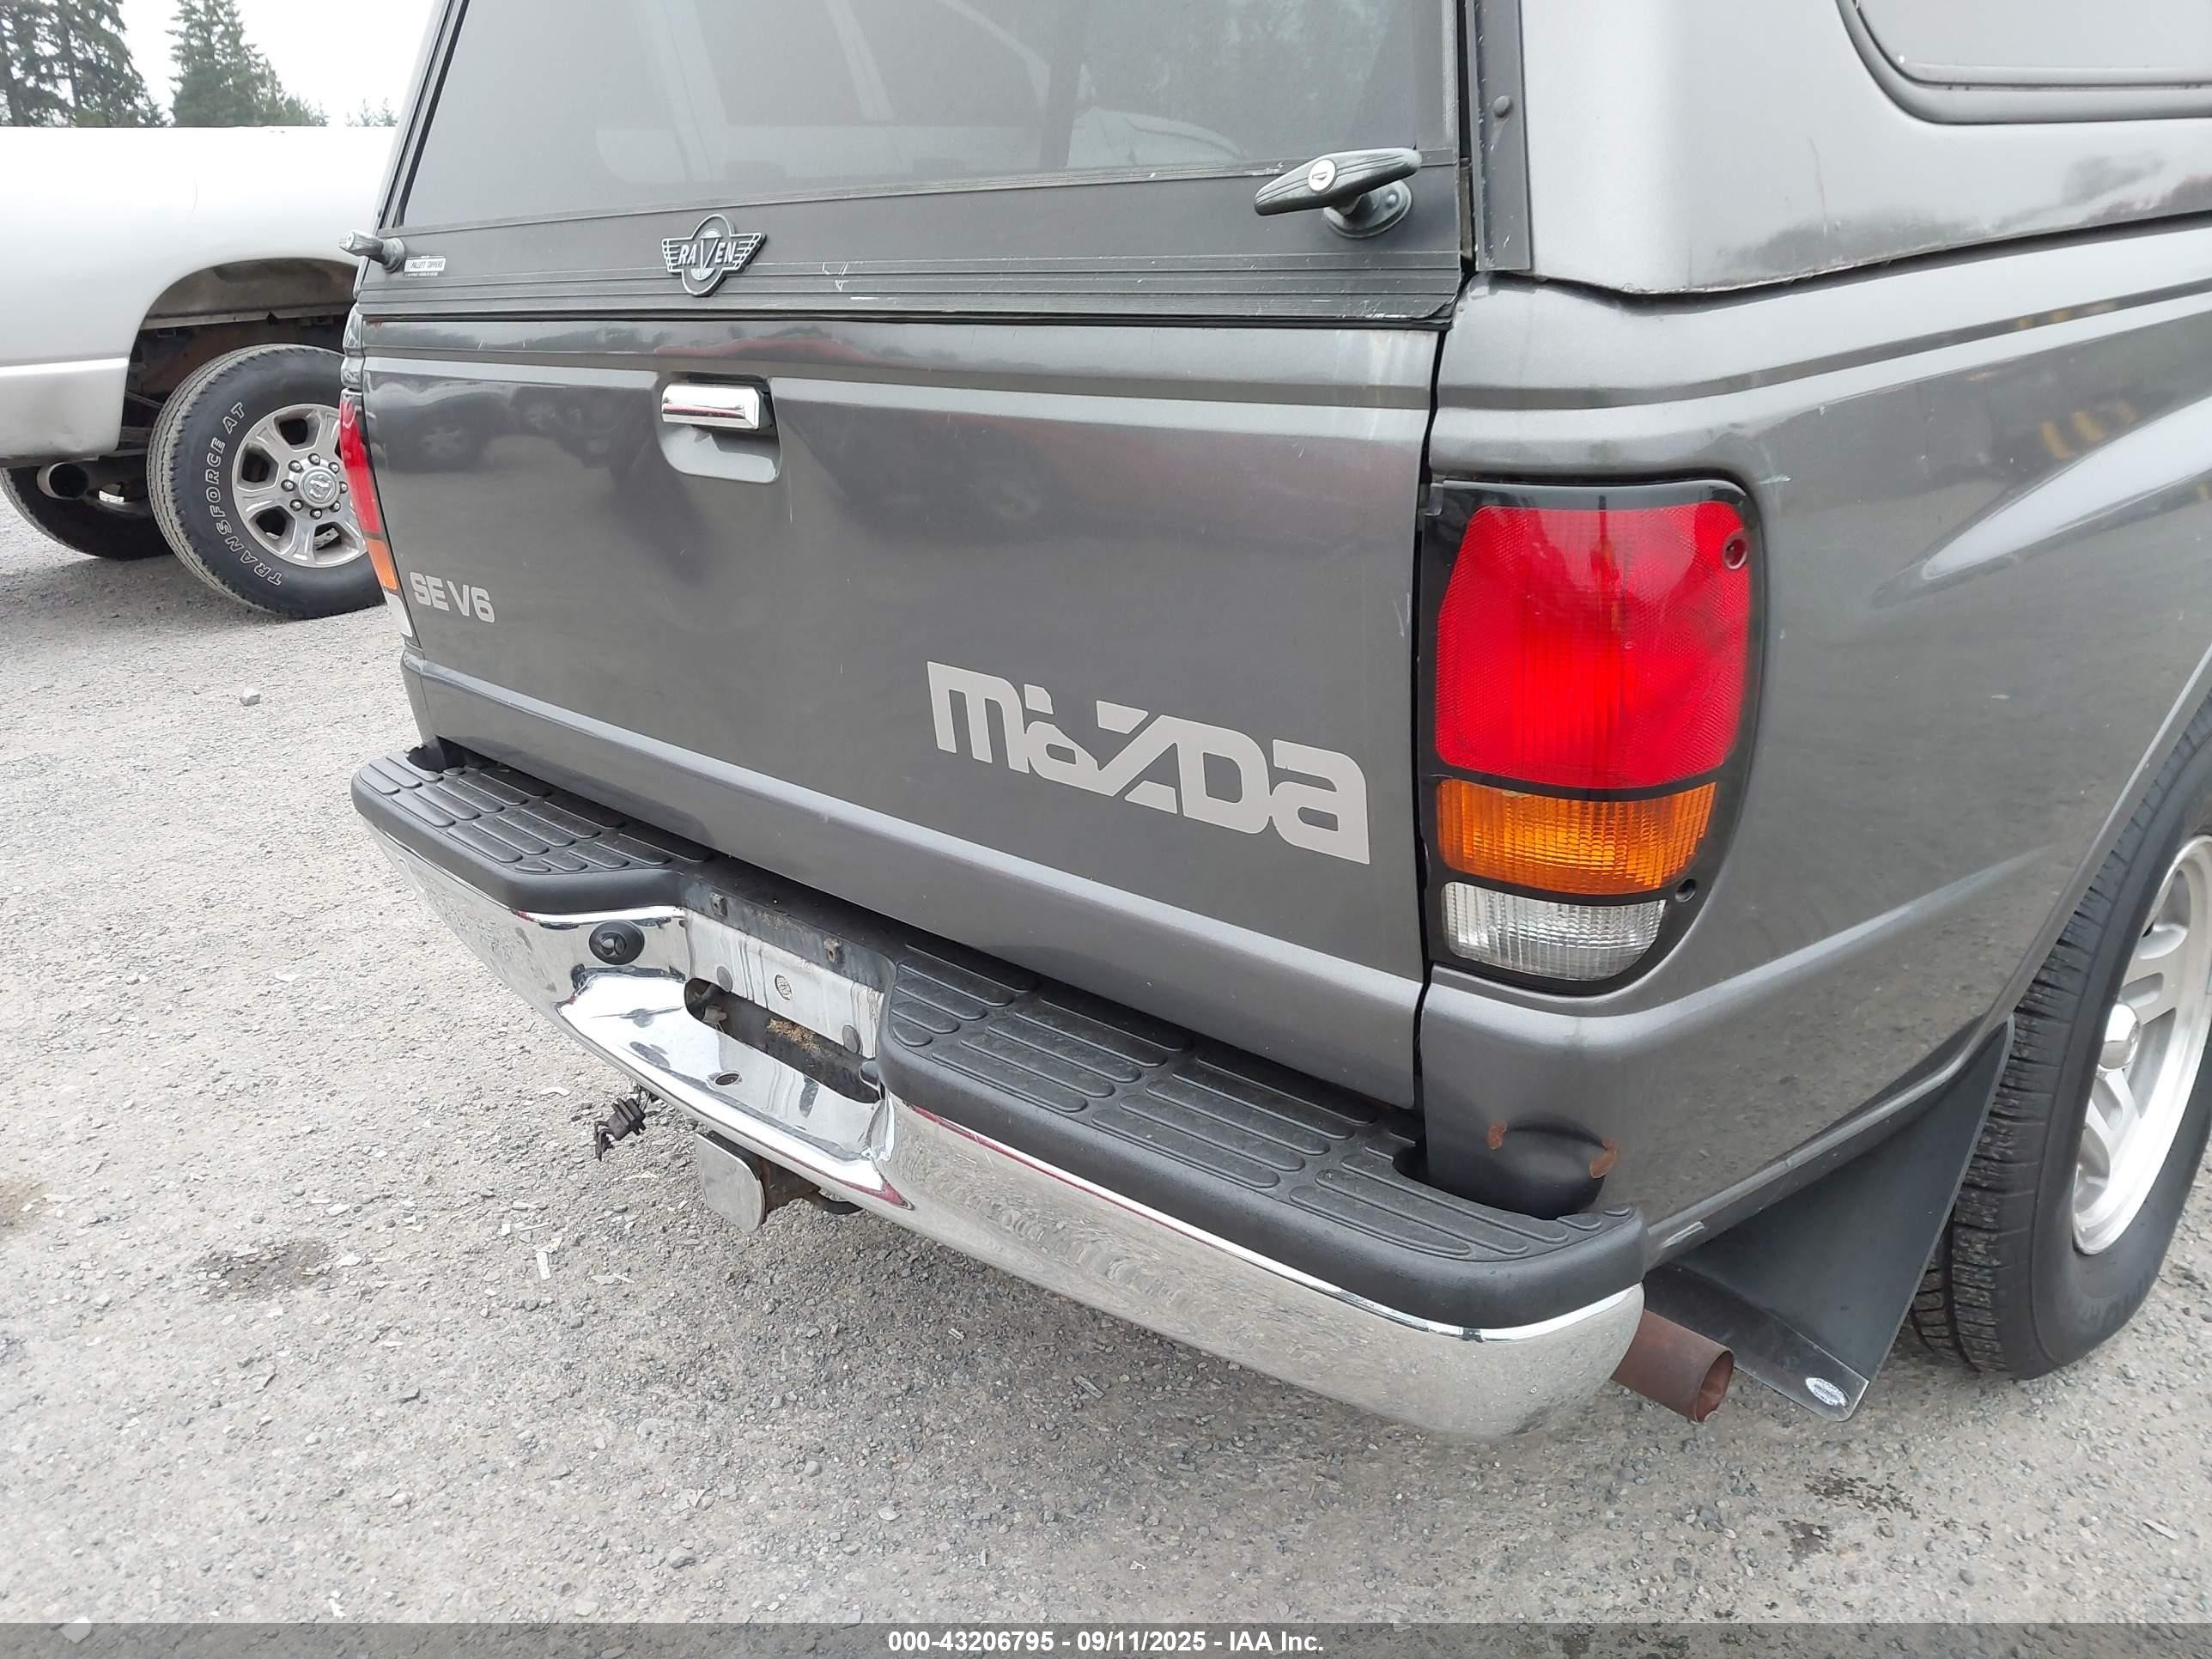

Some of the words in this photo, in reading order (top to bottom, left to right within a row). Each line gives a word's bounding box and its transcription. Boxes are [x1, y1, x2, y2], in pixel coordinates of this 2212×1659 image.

[678, 238, 737, 278] RAVEN
[222, 401, 246, 435] AT
[205, 436, 282, 586] TRANSFORCE
[410, 571, 450, 611] SE
[447, 580, 495, 623] V6
